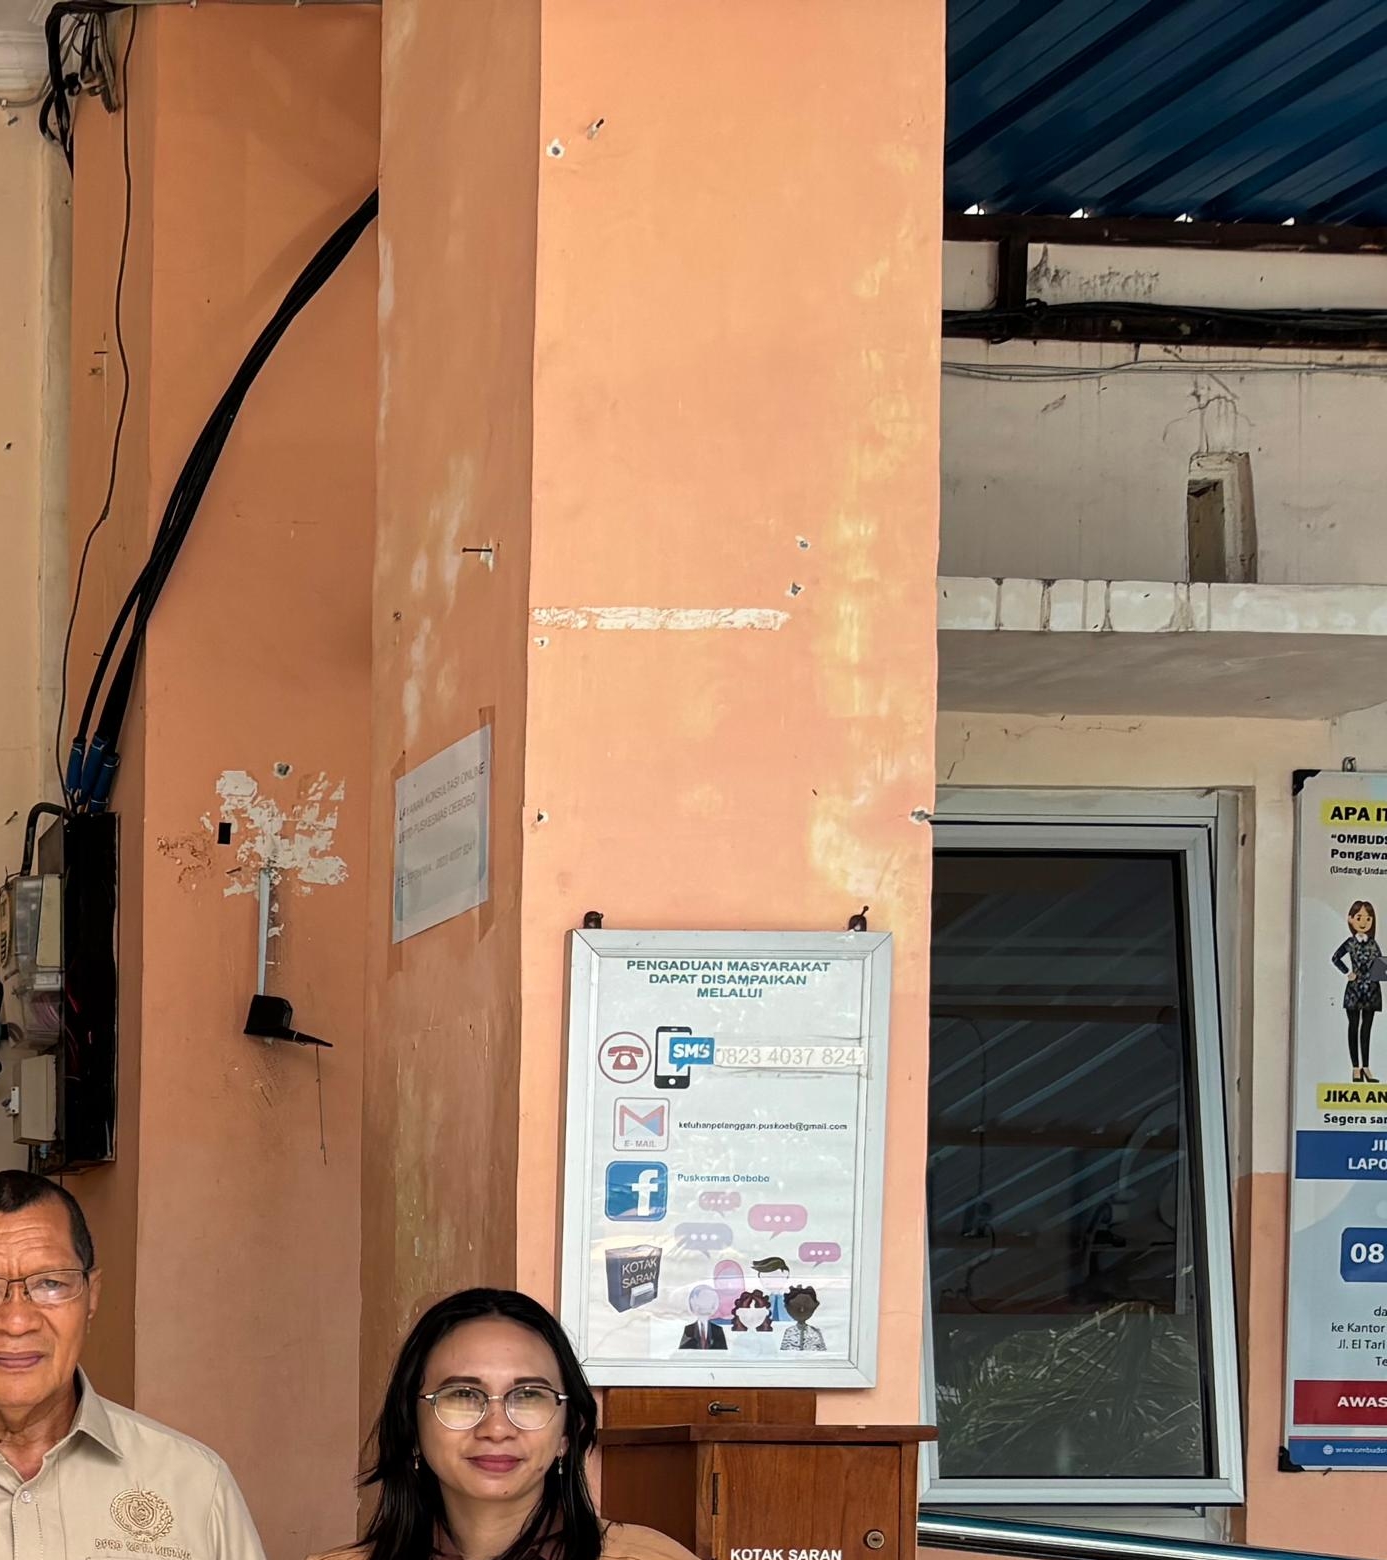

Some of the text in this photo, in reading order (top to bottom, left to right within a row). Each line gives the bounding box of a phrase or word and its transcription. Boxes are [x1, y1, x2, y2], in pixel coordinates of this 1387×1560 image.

[1330, 806, 1370, 821] APA
[627, 960, 831, 972] PENGADUAN MASYARAKAT
[649, 974, 807, 985] DAPAT DISAMPAIKAN
[696, 988, 762, 998] MELALUI
[673, 1044, 710, 1058] SMS
[715, 1048, 762, 1065] 0823
[768, 1048, 815, 1065] 4037
[1324, 1090, 1361, 1103] JIKA
[1324, 1113, 1366, 1126] Segera
[1348, 1158, 1387, 1170] LAPO
[622, 1257, 657, 1275] KOTAK
[622, 1271, 657, 1289] SARAN
[1331, 1322, 1385, 1333] ke Kantor
[1364, 1339, 1385, 1350] Tari
